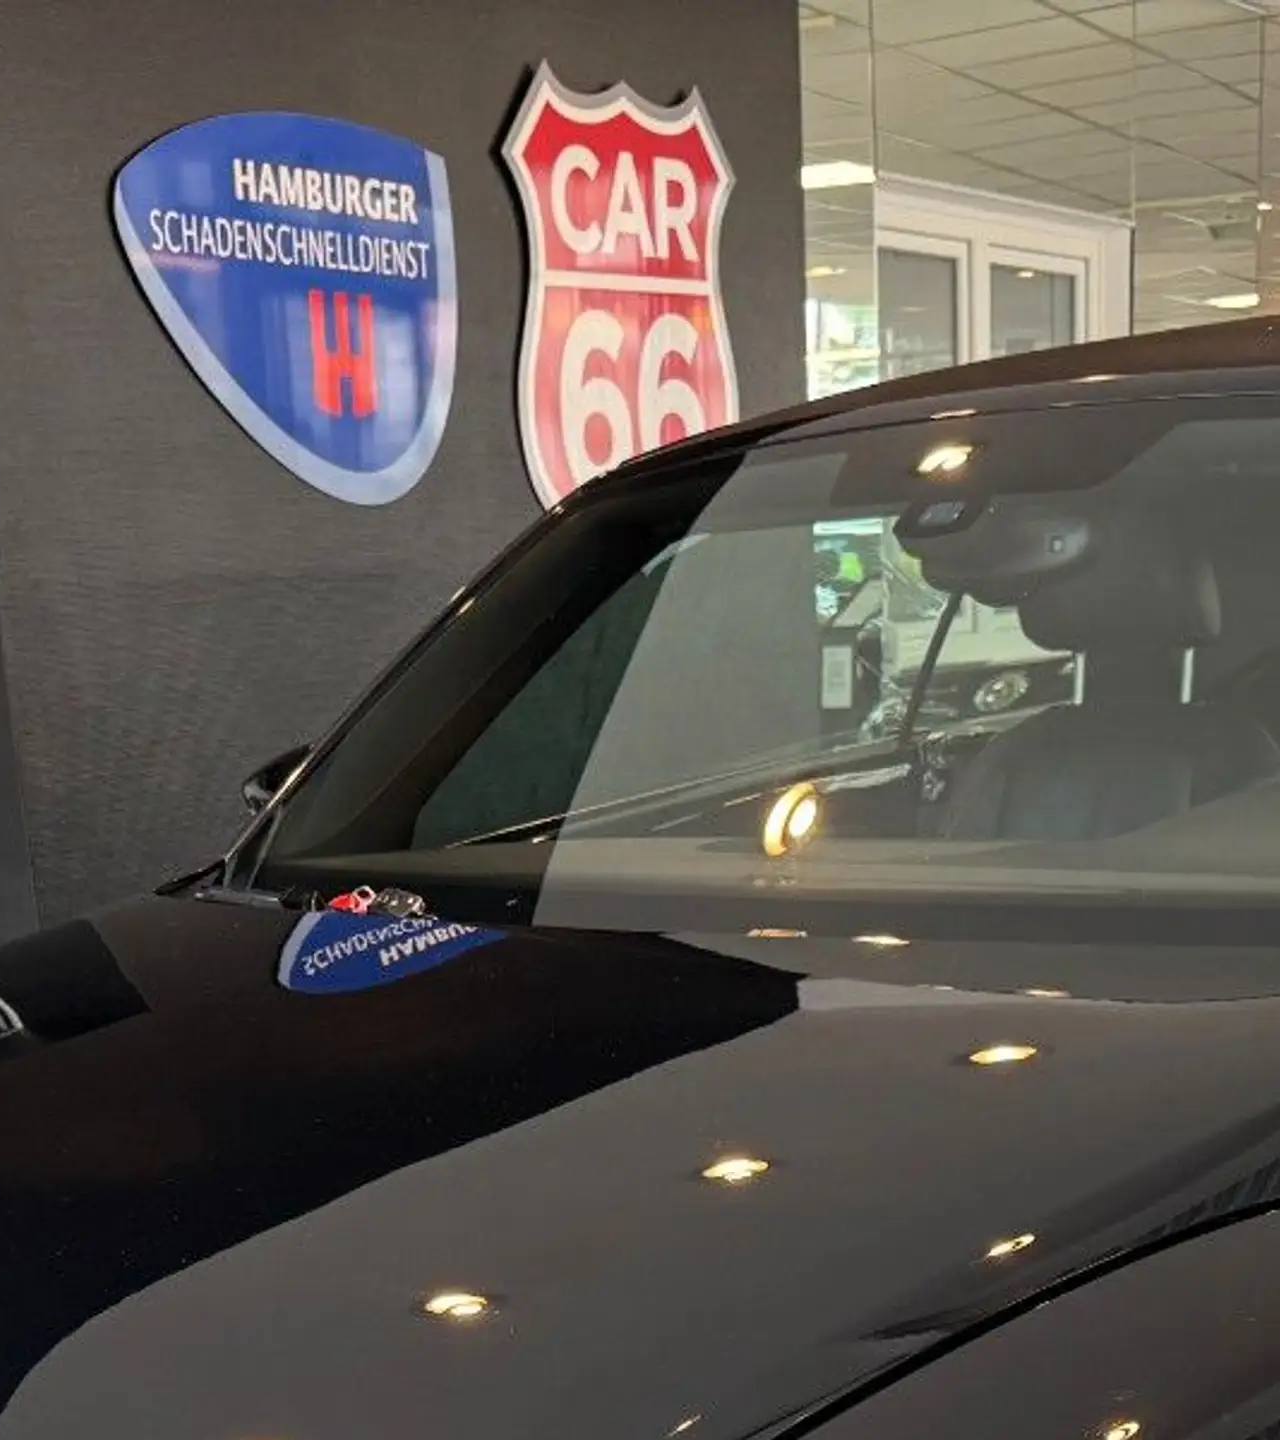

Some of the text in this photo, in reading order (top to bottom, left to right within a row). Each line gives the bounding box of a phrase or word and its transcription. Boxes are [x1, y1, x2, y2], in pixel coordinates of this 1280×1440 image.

[232, 157, 418, 225] HAMBURGER
[550, 144, 701, 262] CAR
[149, 208, 429, 280] SCHADENSCHNELLDIENST
[560, 309, 707, 478] 66
